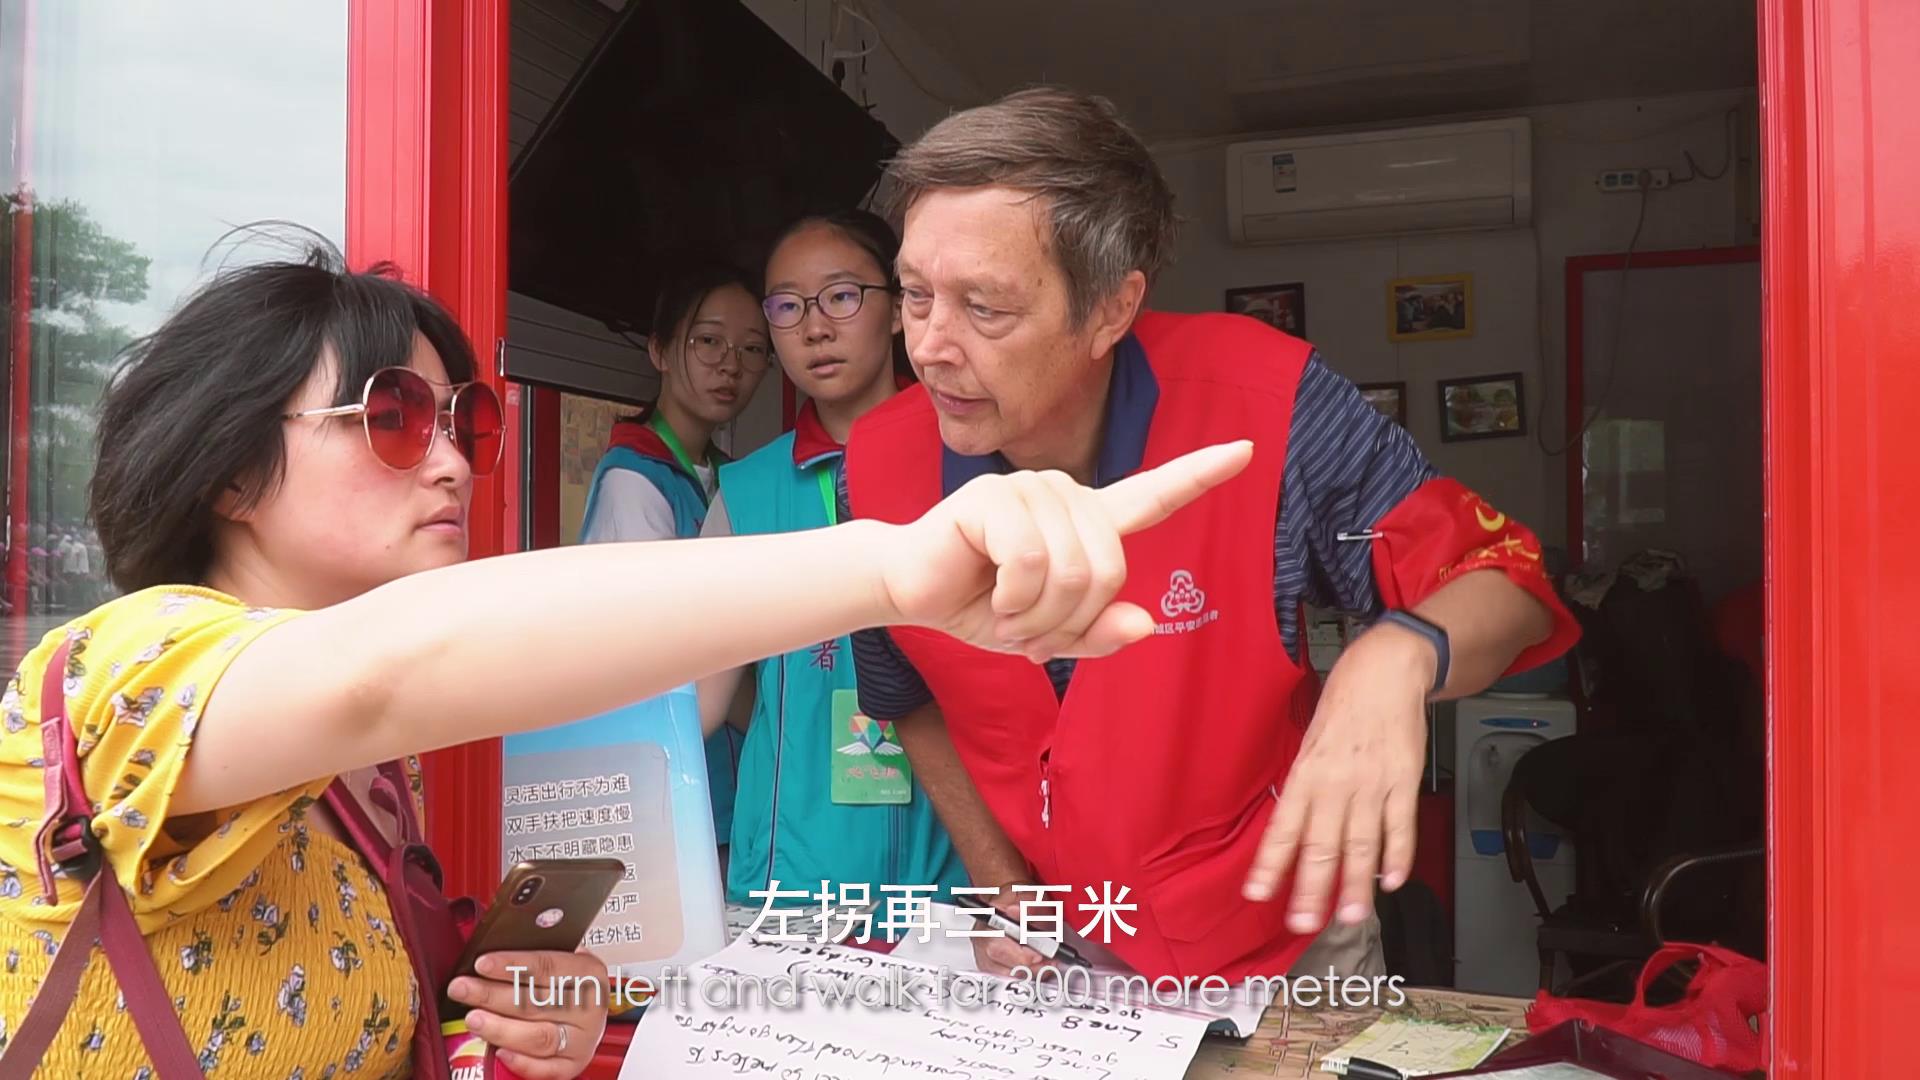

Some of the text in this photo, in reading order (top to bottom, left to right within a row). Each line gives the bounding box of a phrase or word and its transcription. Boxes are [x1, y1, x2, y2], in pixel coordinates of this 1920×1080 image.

[504, 773, 631, 804] 灵活出行不为难
[506, 805, 632, 835] 双手扶把速度慢
[509, 834, 633, 863] 水下不明藏隐患
